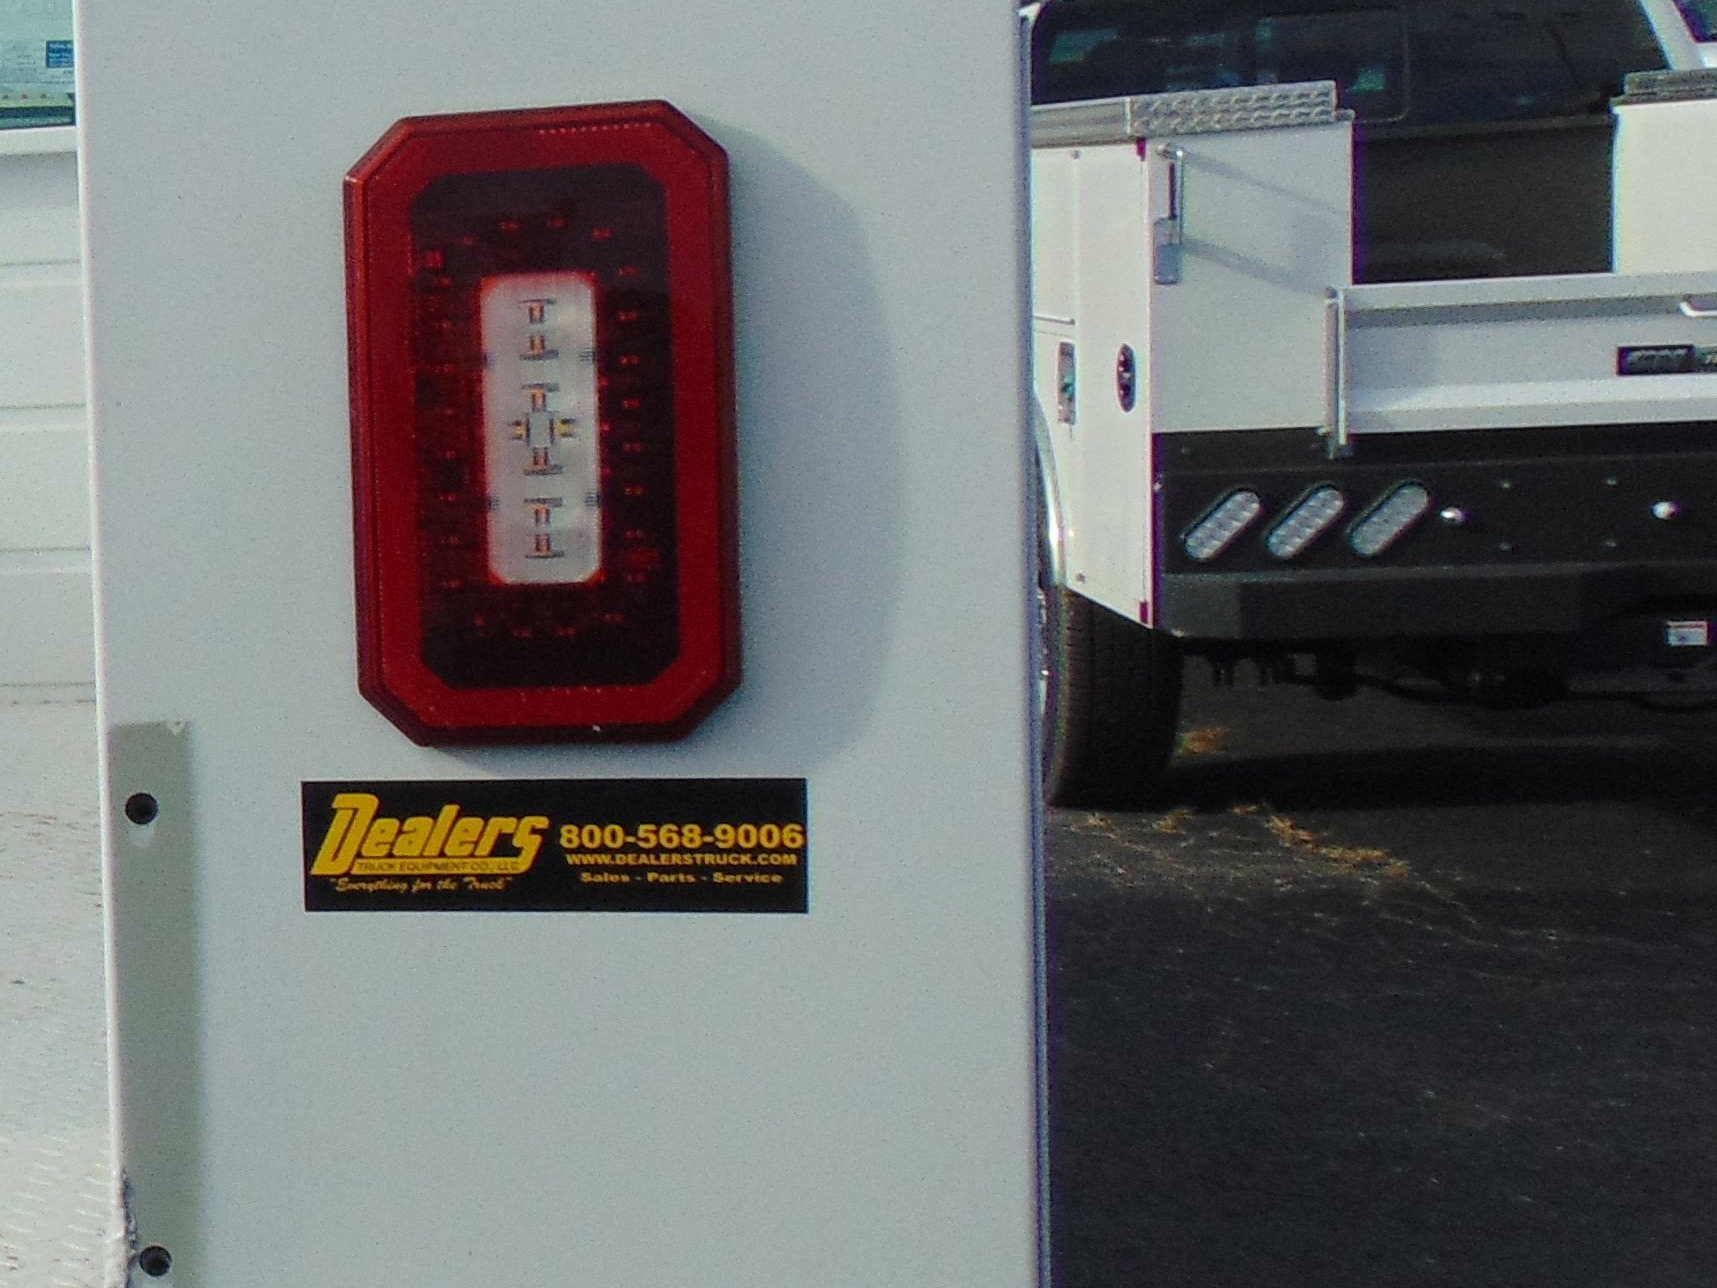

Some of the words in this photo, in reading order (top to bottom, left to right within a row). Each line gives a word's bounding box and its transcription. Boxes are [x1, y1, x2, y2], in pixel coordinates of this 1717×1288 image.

[310, 793, 550, 876] Dealers
[559, 824, 804, 849] 800-568-9006
[566, 853, 798, 866] WWW.DEALERSTRUCK.COM
[357, 861, 396, 872] TRUCK
[399, 861, 468, 872] EQUIPMENT
[579, 872, 630, 883] Sales
[646, 872, 697, 883] Parts
[713, 872, 782, 883] Service
